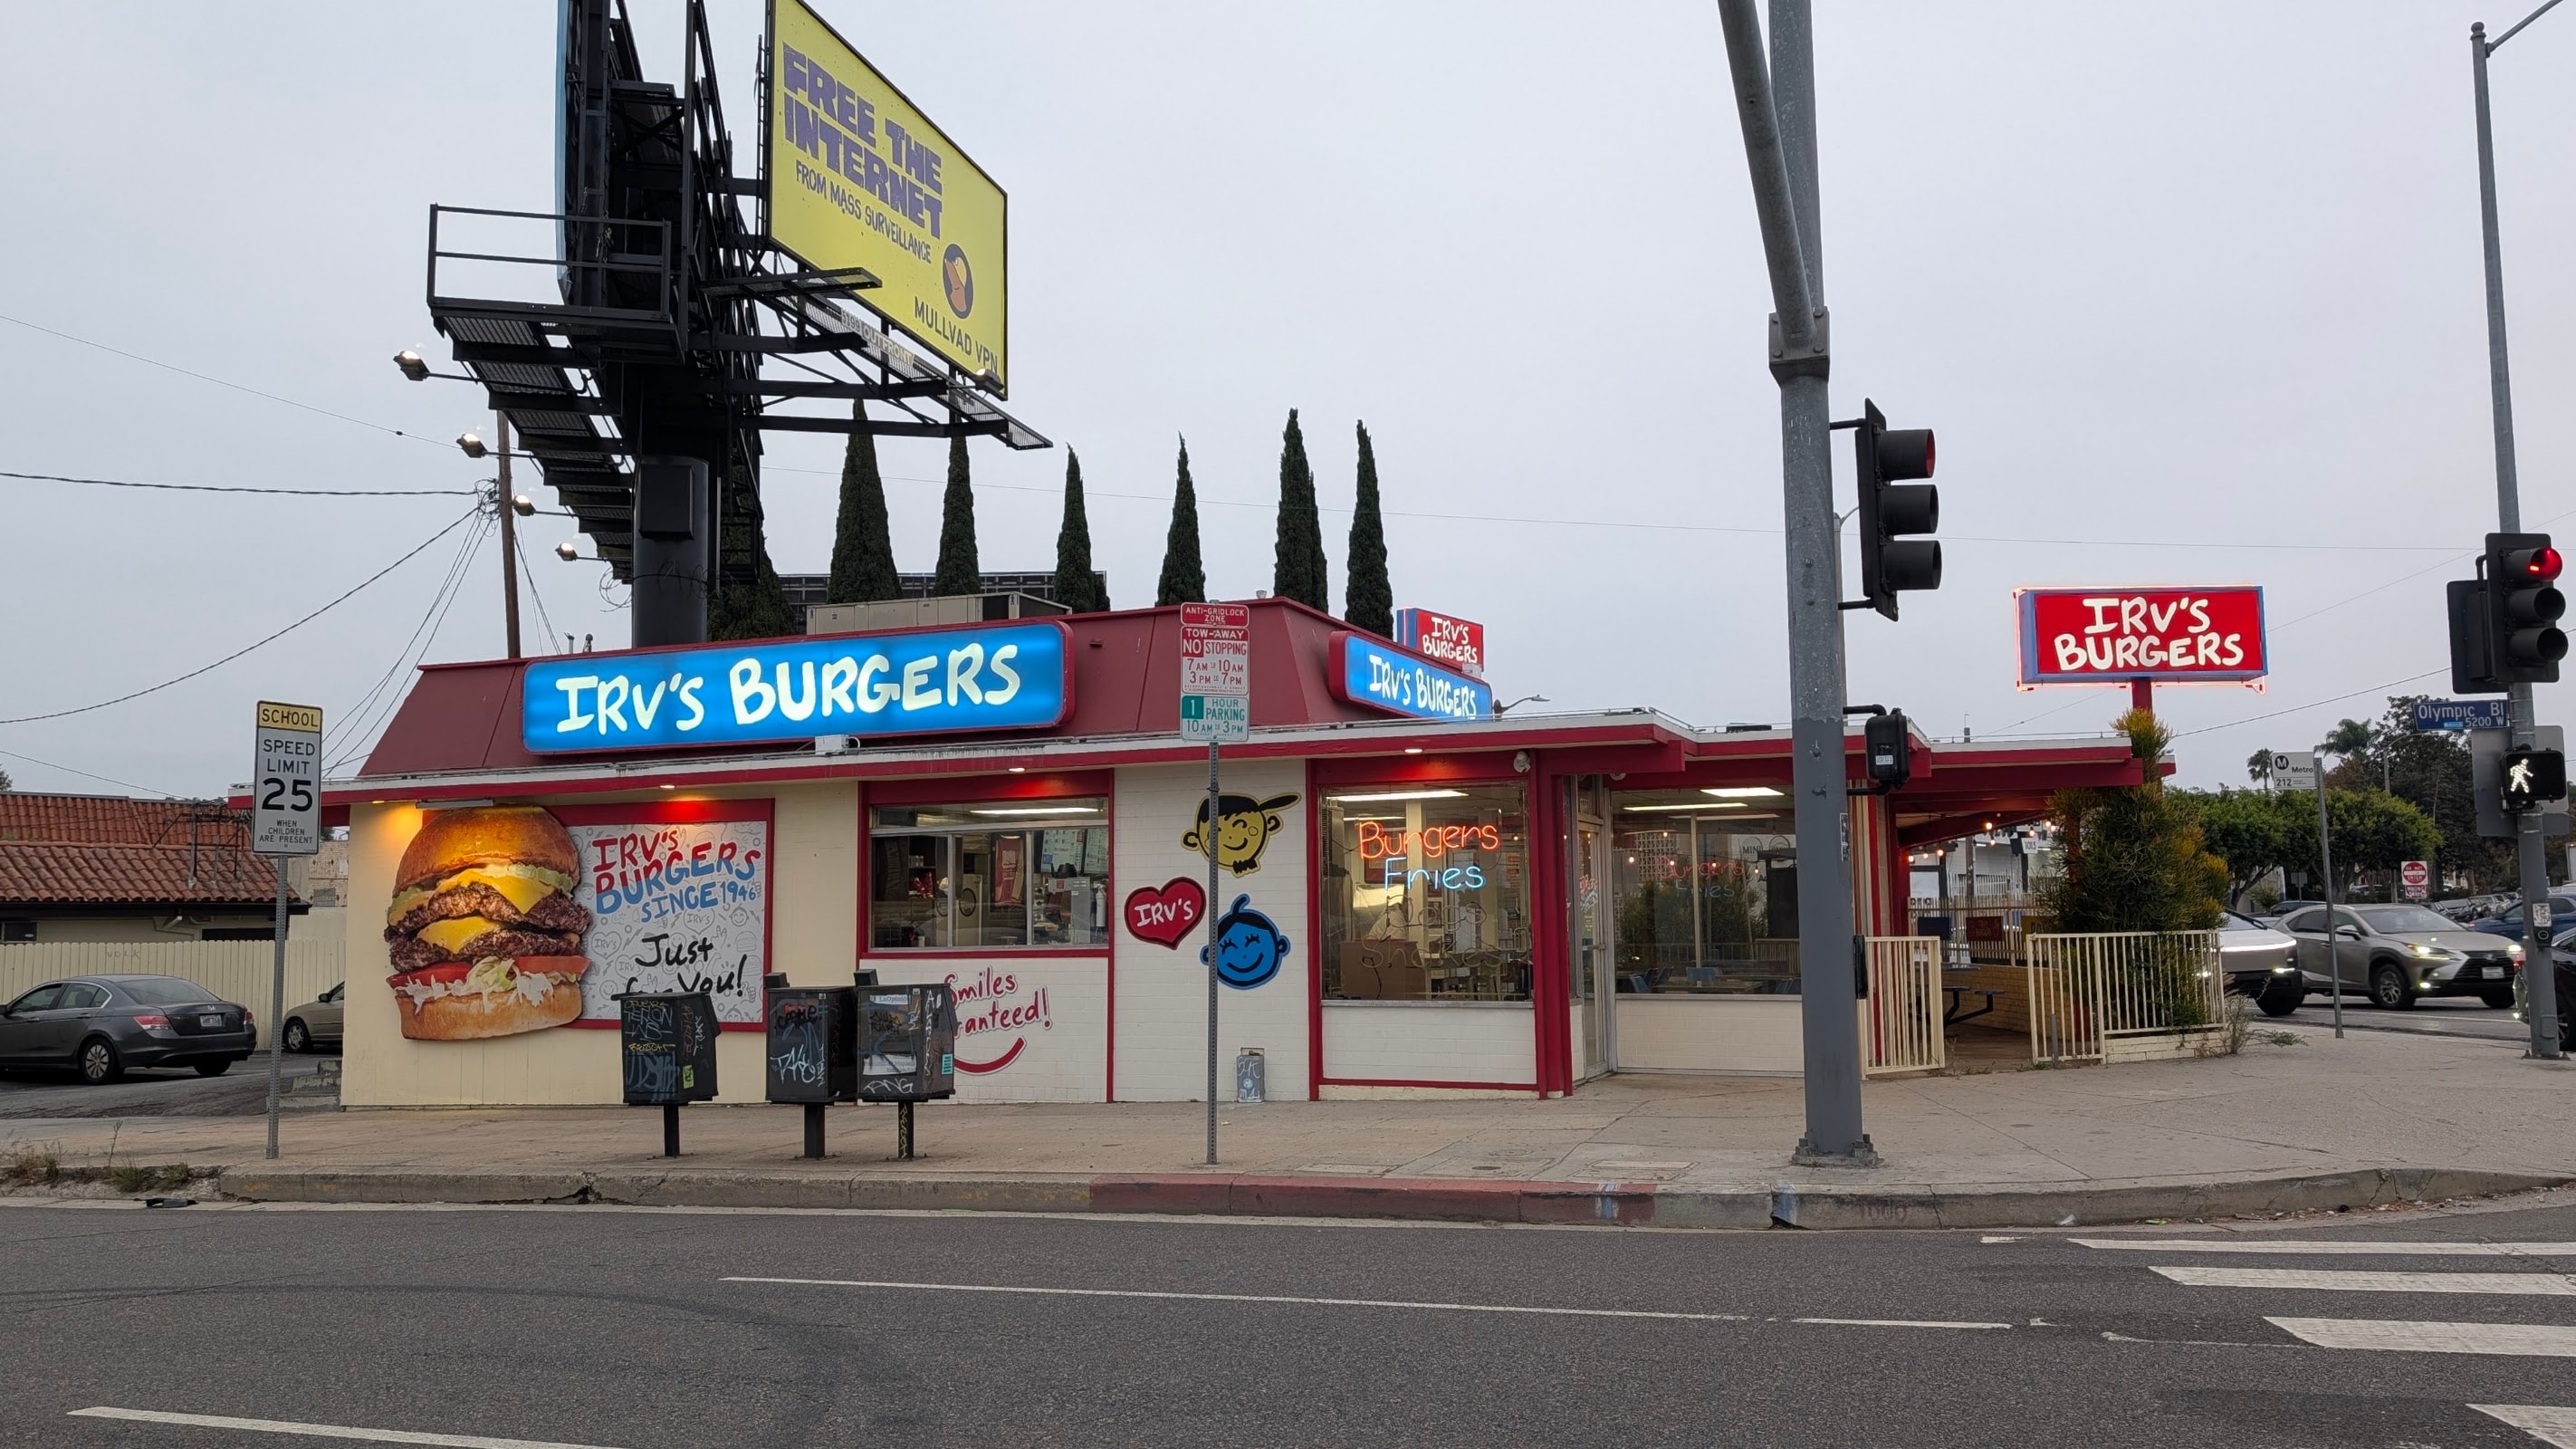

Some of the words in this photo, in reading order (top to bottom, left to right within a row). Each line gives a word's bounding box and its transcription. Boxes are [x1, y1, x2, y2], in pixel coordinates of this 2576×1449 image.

[782, 42, 876, 148] FREE
[885, 118, 942, 196] THE
[784, 92, 942, 240] INTERNET
[796, 159, 828, 200] FROM
[830, 184, 861, 220] MASS
[915, 296, 972, 355] MULLVAD
[975, 341, 998, 372] VPN
[1185, 607, 1245, 617] ANTI-GRIDLOCK
[2083, 596, 2211, 635] IRV'S
[1185, 628, 1245, 639] TOW-AWAY
[1432, 617, 1469, 644] IRV'S
[1183, 638, 1202, 654] NO
[1205, 641, 1247, 657] STOPPING
[1422, 635, 1478, 664] BURGERS
[2054, 632, 2244, 671] BURGERS
[1187, 658, 1194, 671] 7
[1196, 663, 1208, 671] AM
[1218, 659, 1231, 672] 10
[1232, 664, 1243, 672] AM
[555, 672, 705, 735] IRV'S
[729, 642, 1020, 724] BURGERS
[1189, 671, 1196, 684] 3
[1199, 676, 1211, 684] PM
[1221, 673, 1229, 685] 7
[1230, 677, 1241, 685] PM
[1369, 654, 1412, 706] IRV'S
[1415, 667, 1477, 720] BURGERS
[262, 708, 318, 727] SCHOOL
[1191, 699, 1195, 716] 1
[1211, 698, 1240, 707] HOUR
[1206, 708, 1245, 722] PARKING
[2418, 705, 2475, 722] Olympic
[2490, 702, 2504, 716] Bl
[1186, 720, 1199, 733] 10
[1201, 724, 1212, 732] AM
[1222, 721, 1230, 733] 3
[1231, 725, 1243, 734] PM
[2465, 716, 2491, 727] 5200
[2496, 716, 2504, 726] W
[263, 739, 315, 755] SPEED
[267, 758, 310, 774] LIMIT
[262, 777, 312, 811] 25
[2275, 778, 2292, 787] 212
[268, 828, 305, 836] CHILDREN
[276, 820, 297, 828] WHEN
[259, 834, 274, 843] ARE
[279, 836, 312, 844] PRESENT
[1359, 820, 1500, 859] Burgers
[592, 830, 678, 872] IRV'S
[597, 841, 761, 914] BURGERS
[1384, 857, 1486, 891] Fries
[641, 882, 718, 923] SINCE
[720, 880, 757, 904] 1946
[1135, 899, 1193, 927] IRV'S
[686, 913, 712, 925] IRV'S
[594, 938, 618, 949] IRV'S
[635, 933, 713, 966] Just
[1361, 935, 1503, 968] Shakes
